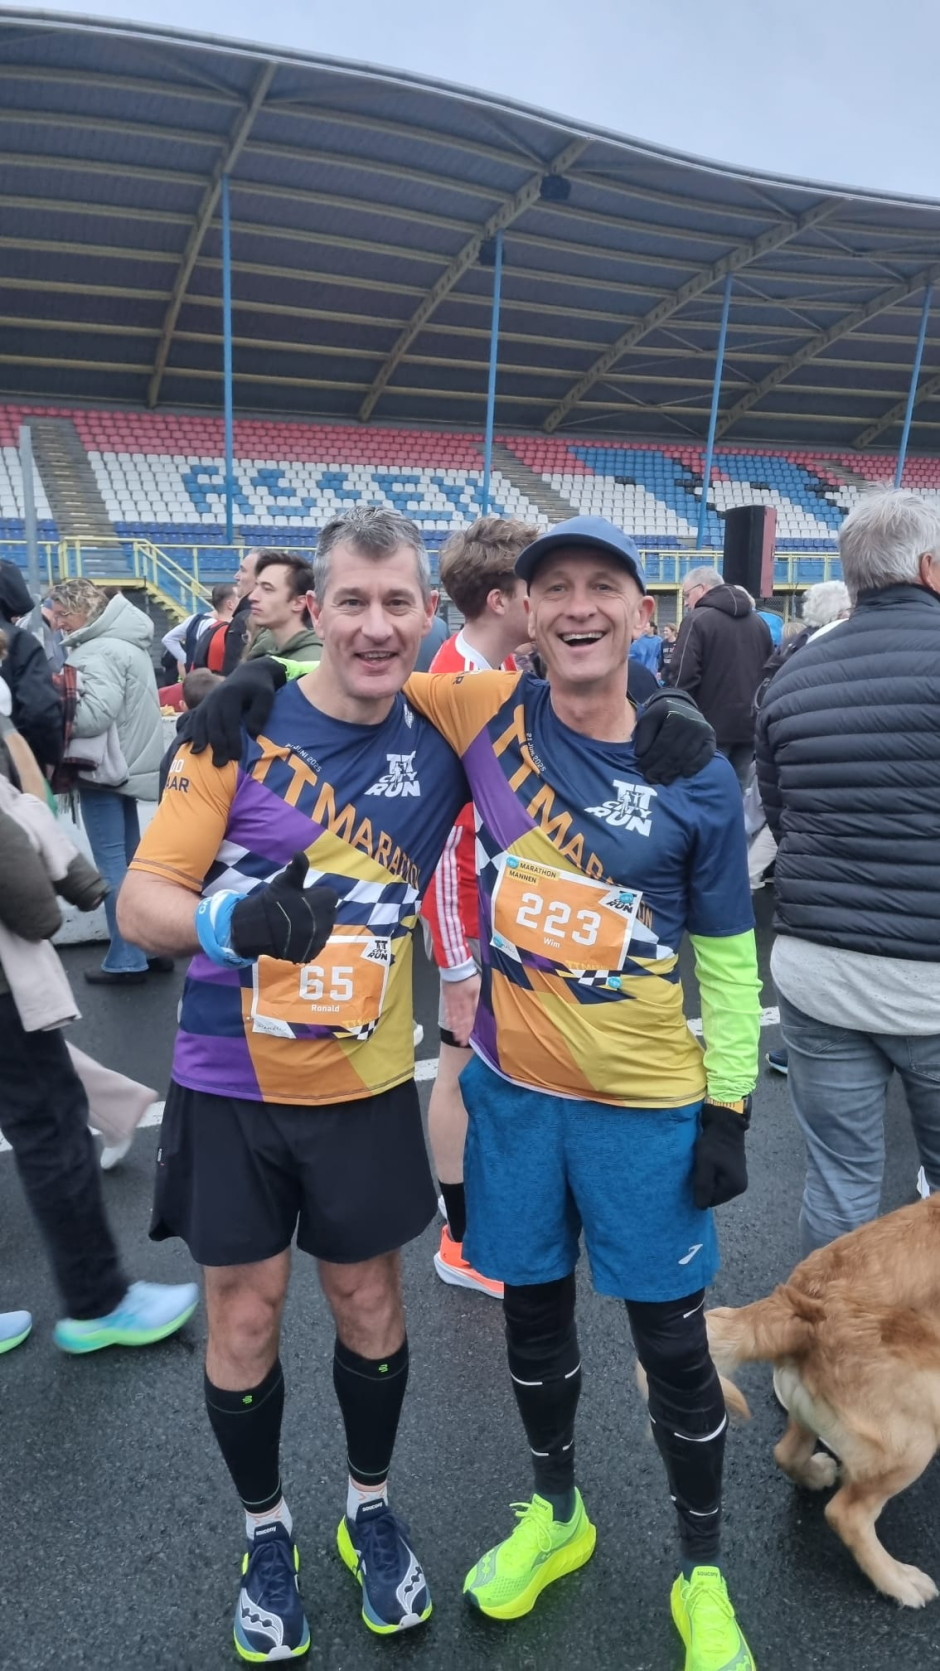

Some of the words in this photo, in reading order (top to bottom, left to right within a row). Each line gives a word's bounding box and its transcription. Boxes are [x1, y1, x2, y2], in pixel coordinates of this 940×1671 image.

[492, 704, 541, 793] TT
[252, 734, 318, 808] TT
[386, 750, 417, 775] TT
[364, 780, 421, 798] RUN
[612, 779, 658, 811] TT
[583, 805, 653, 837] RUN
[509, 870, 537, 884] MANNEN
[520, 862, 557, 879] MARATHON
[605, 900, 634, 914] RUN
[515, 892, 602, 946] 223
[374, 940, 388, 950] TT
[543, 936, 561, 949] Wim
[366, 952, 388, 961] RUN
[298, 965, 354, 1001] 65
[311, 1003, 340, 1013] Ronald
